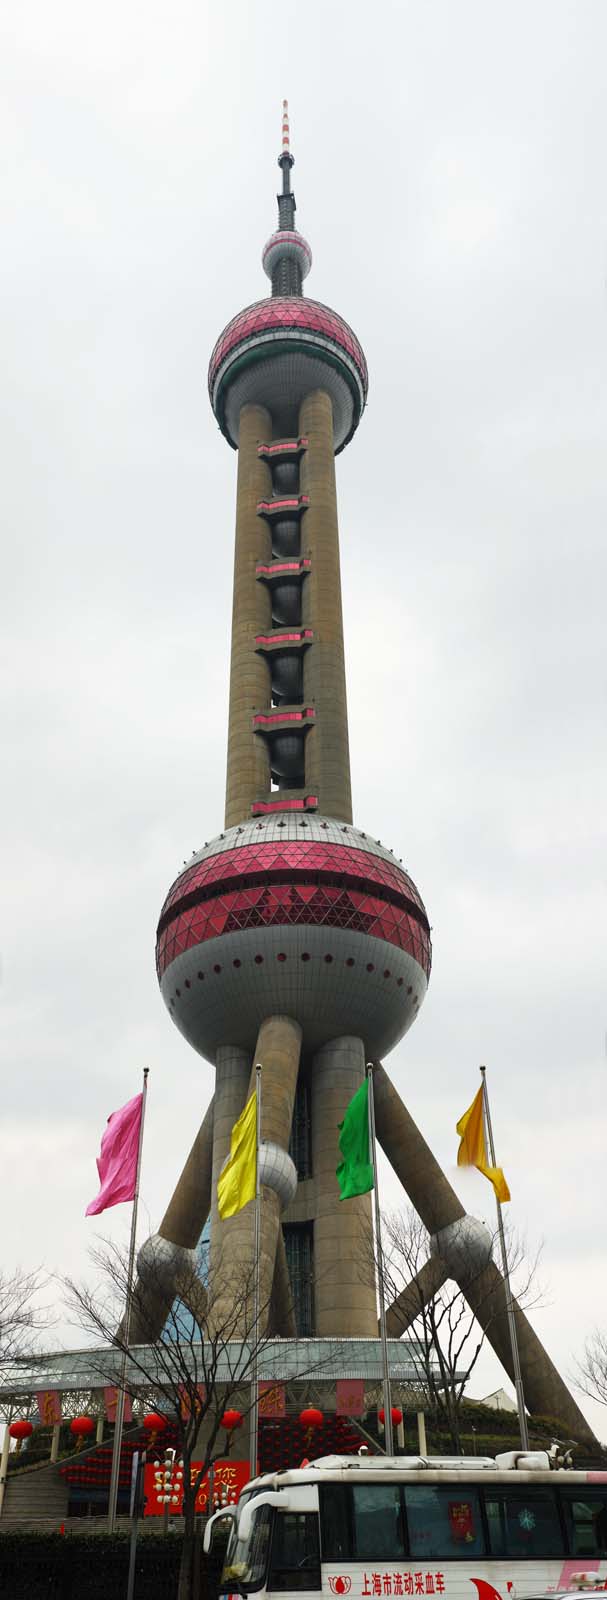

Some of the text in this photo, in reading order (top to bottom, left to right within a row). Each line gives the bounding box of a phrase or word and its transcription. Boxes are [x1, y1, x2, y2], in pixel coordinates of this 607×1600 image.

[362, 1572, 445, 1596] 上海市流动采血车
